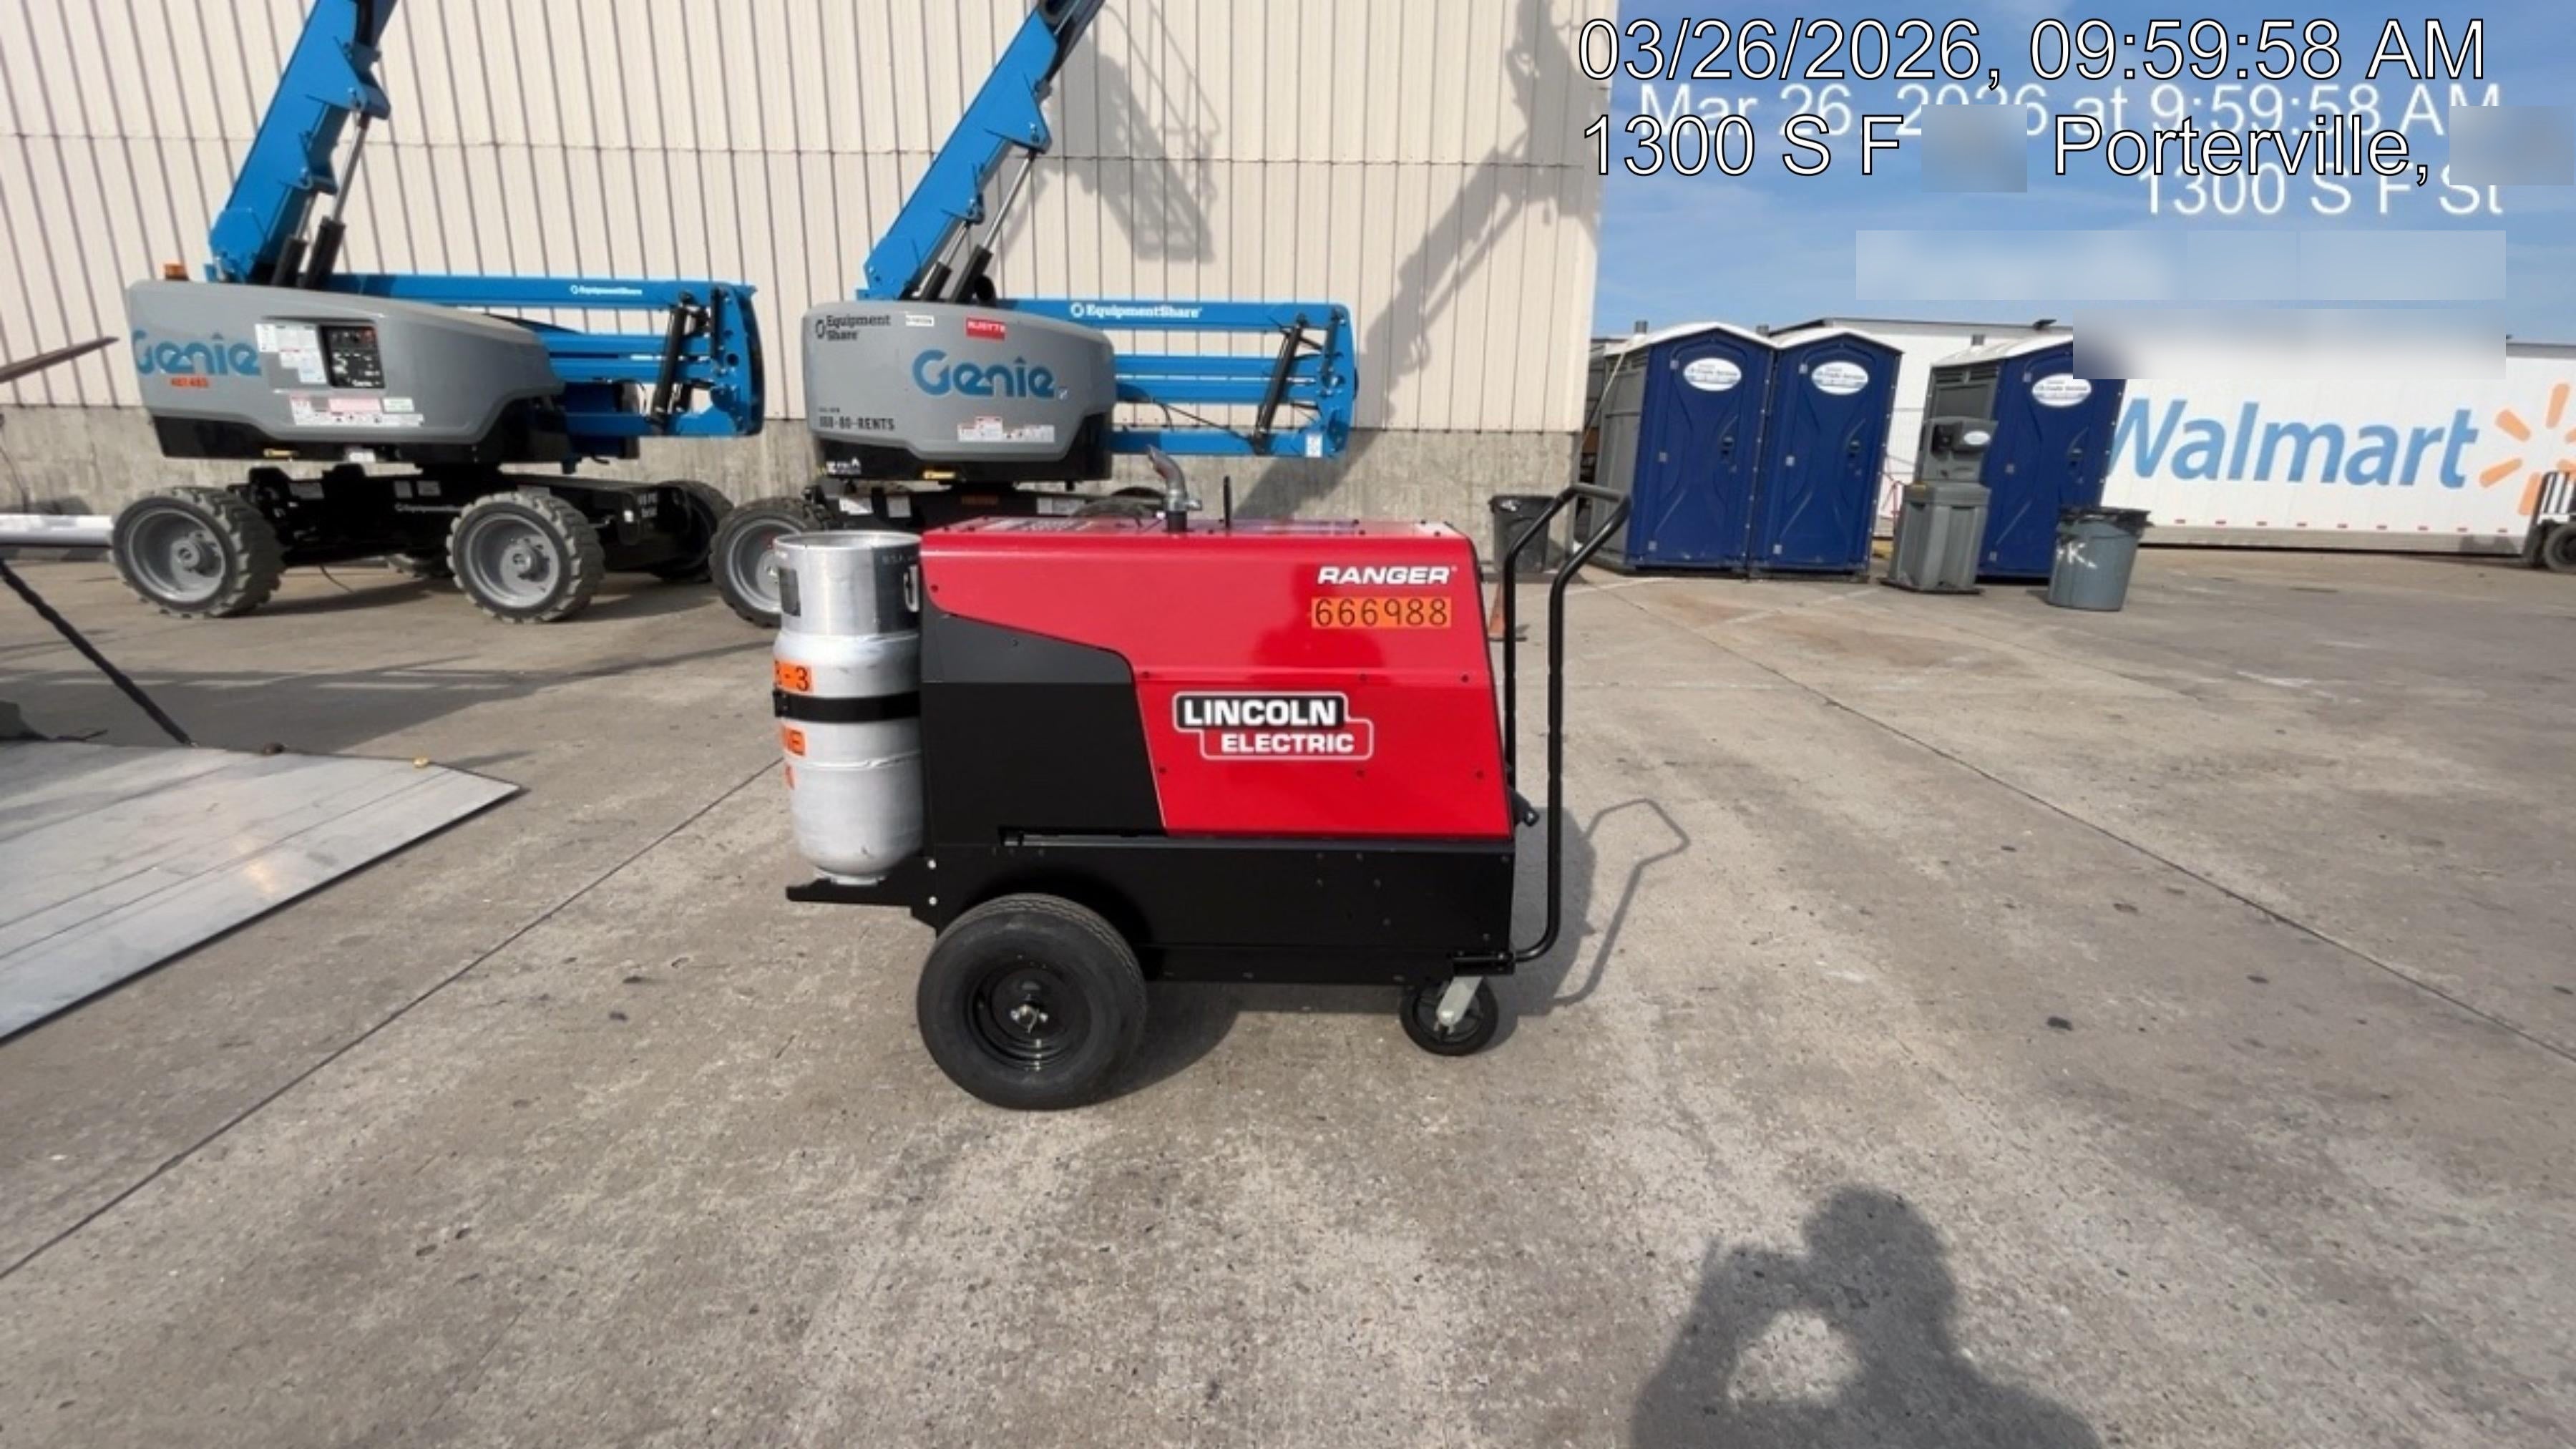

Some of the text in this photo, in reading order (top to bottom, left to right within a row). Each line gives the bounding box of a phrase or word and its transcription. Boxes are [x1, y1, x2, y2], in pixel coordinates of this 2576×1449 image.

[826, 314, 891, 328] Equipment
[131, 329, 263, 376] Genie
[913, 348, 1055, 398] Genie
[2107, 397, 2479, 488] Walmart
[1317, 566, 1450, 585] RANGER
[1315, 598, 1448, 626] 666988
[1184, 700, 1336, 726] LINCOLN
[1221, 733, 1355, 753] ELECTRIC
